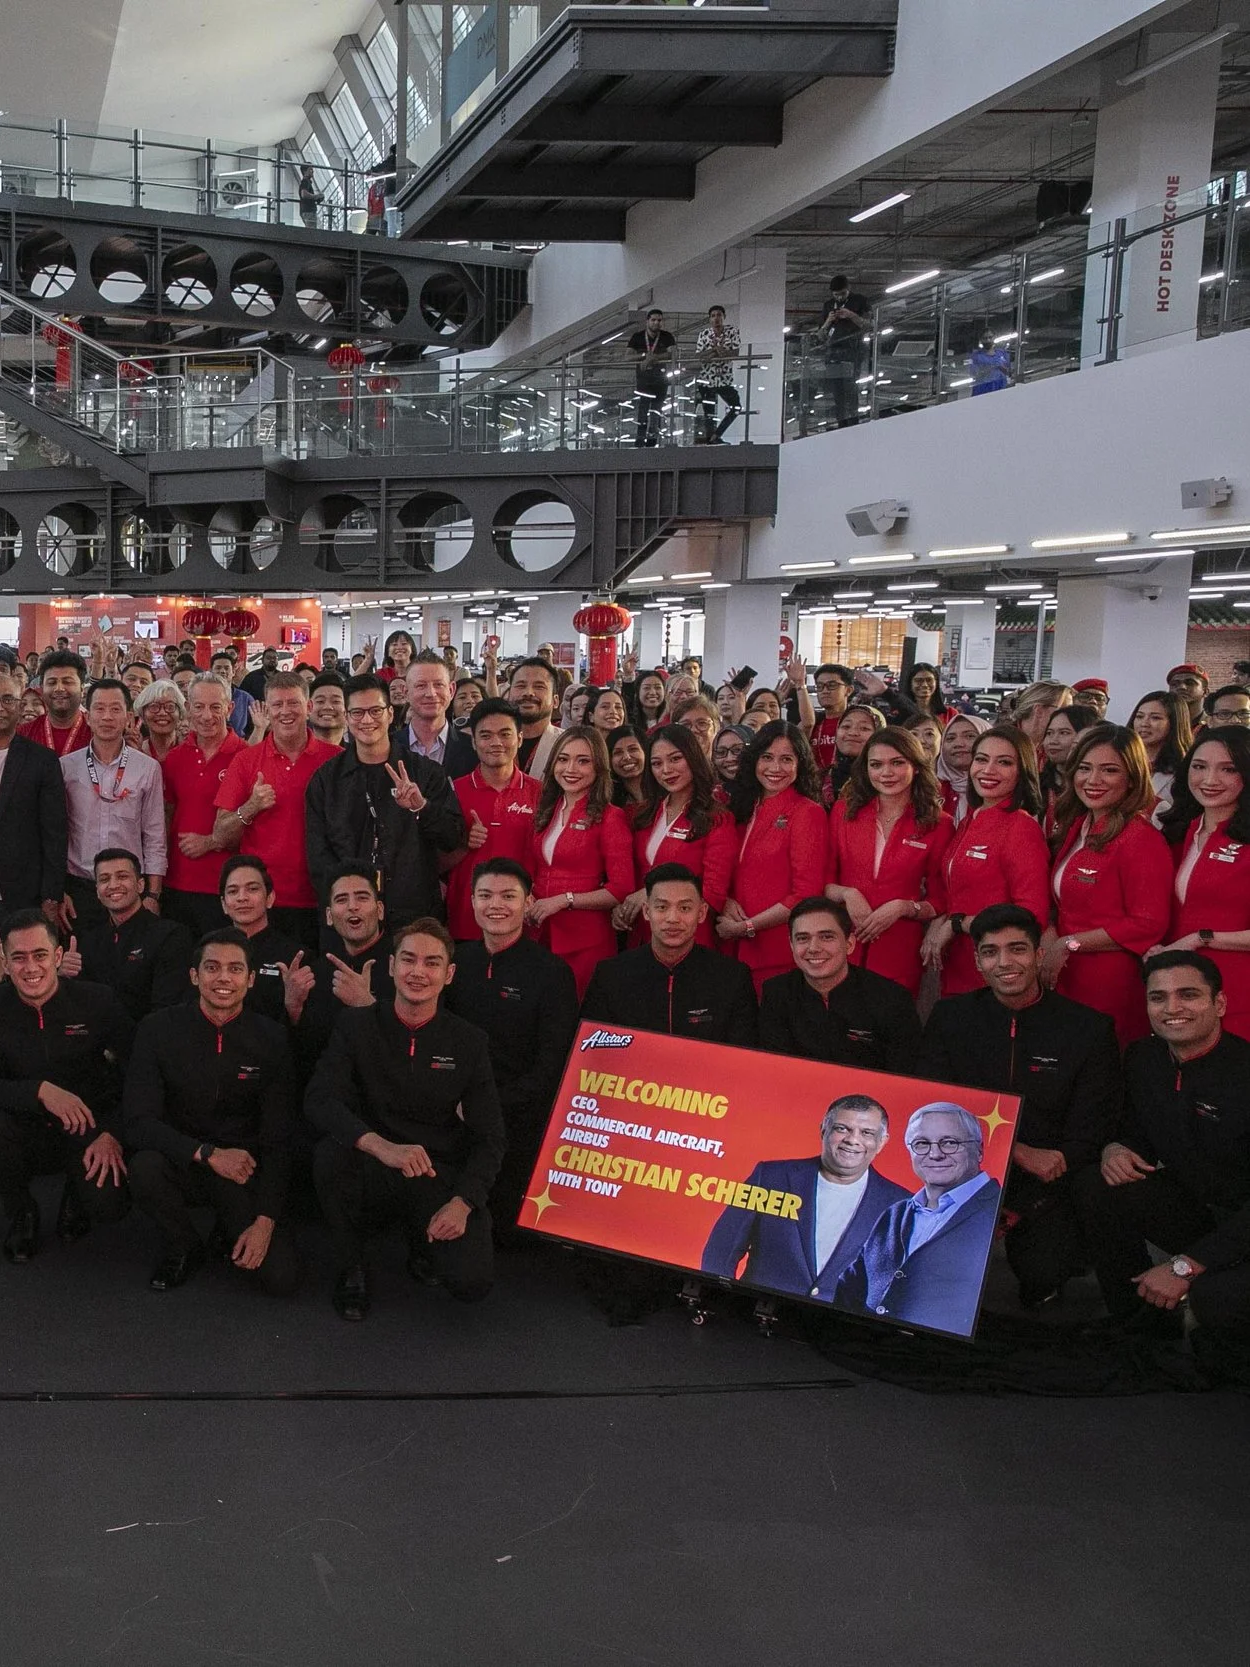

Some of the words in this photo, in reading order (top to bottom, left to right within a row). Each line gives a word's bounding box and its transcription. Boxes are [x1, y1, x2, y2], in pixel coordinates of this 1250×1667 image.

[1163, 175, 1180, 224] ZONE
[1160, 226, 1175, 271] DESK
[1157, 276, 1171, 312] HOT
[580, 1029, 633, 1051] Allstars
[571, 1095, 600, 1114] CEO,
[579, 1069, 729, 1119] WELCOMING
[560, 1127, 610, 1149] AIRBUS
[566, 1111, 653, 1141] COMMERCIAL
[655, 1129, 725, 1158] AIRCRAFT,
[548, 1169, 581, 1190] WITH
[584, 1177, 623, 1198] TONY
[554, 1145, 682, 1193] CHRISTIAN
[684, 1173, 803, 1221] SCHERER
